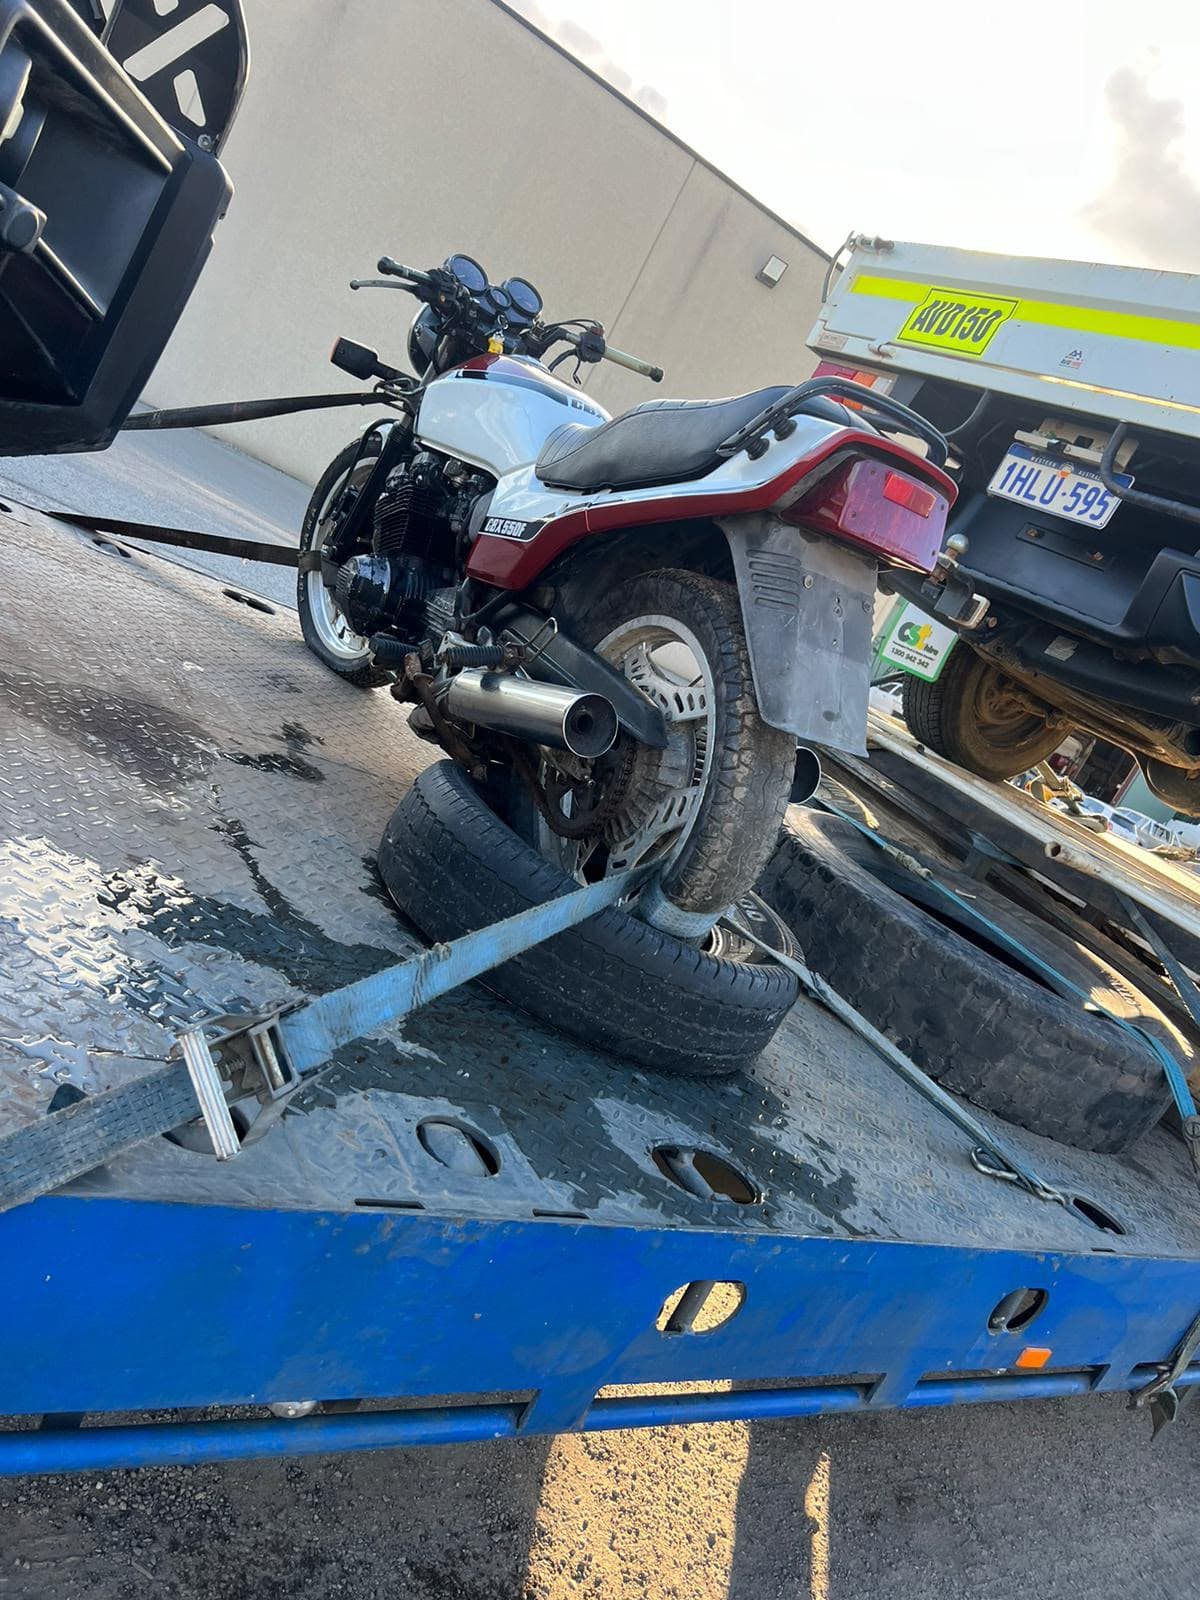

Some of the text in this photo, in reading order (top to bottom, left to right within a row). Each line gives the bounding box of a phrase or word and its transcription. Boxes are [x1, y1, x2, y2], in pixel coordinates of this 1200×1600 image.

[909, 299, 1003, 343] AVD150
[484, 518, 528, 538] CBX550F
[891, 647, 905, 657] 1300
[904, 652, 918, 664] 942
